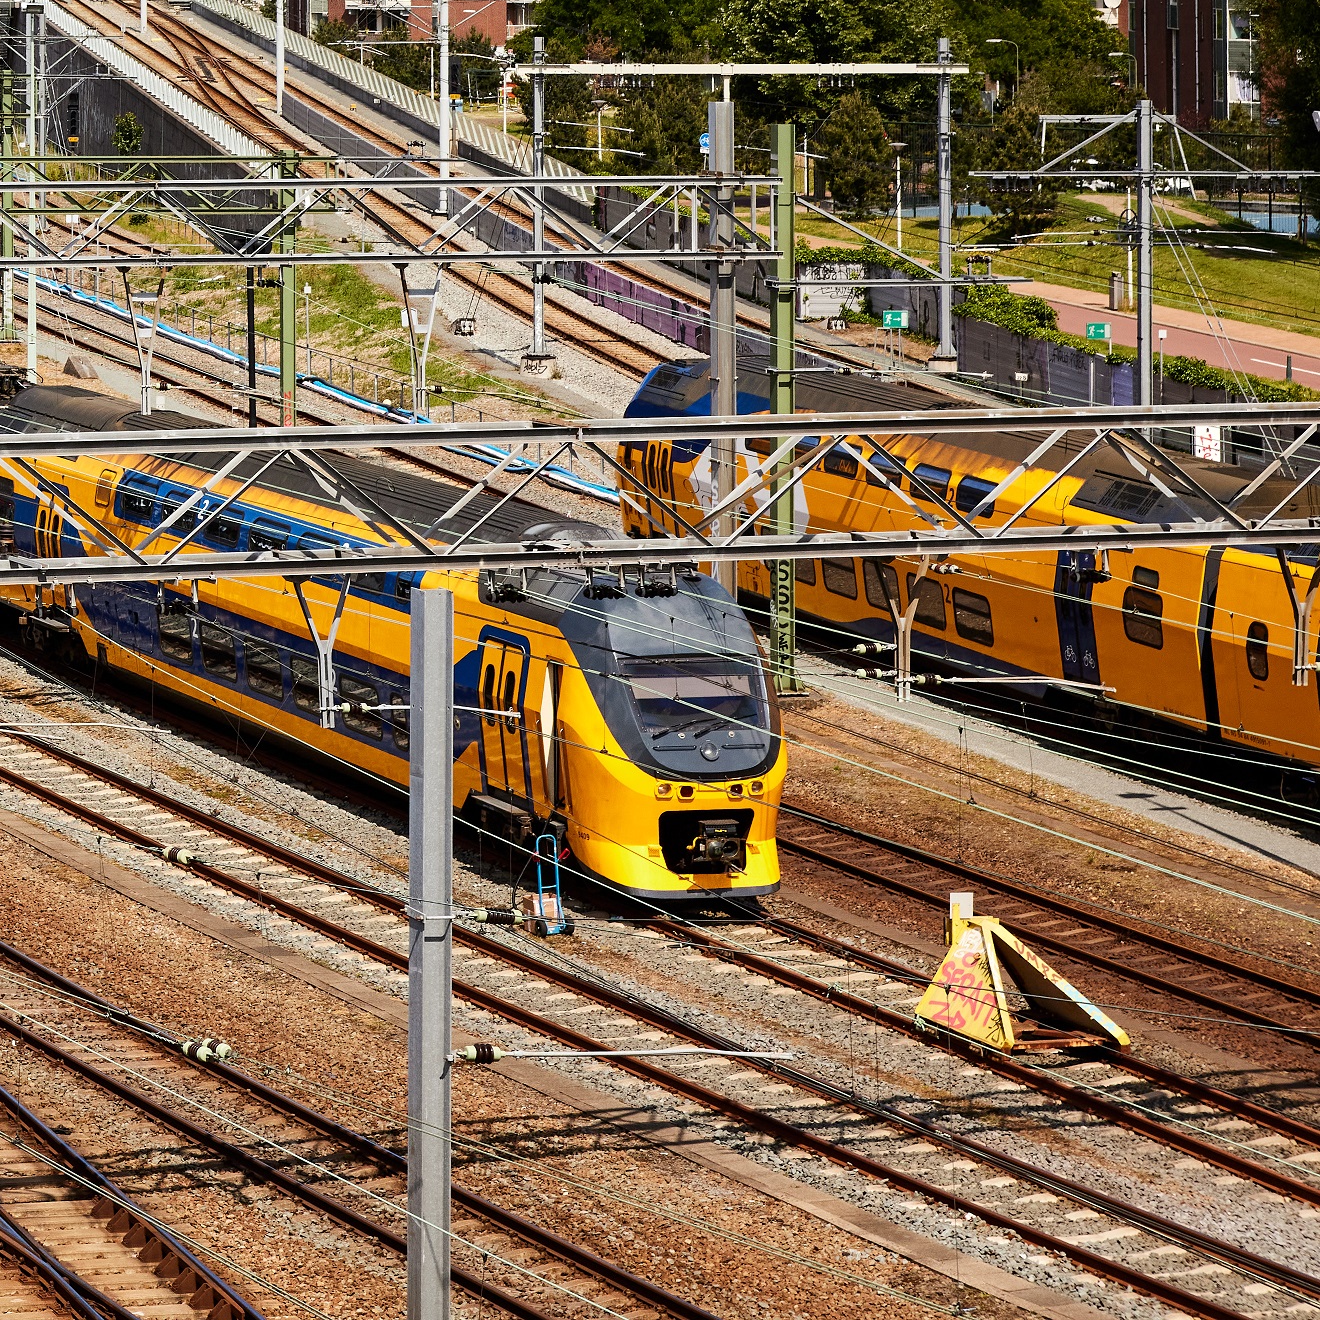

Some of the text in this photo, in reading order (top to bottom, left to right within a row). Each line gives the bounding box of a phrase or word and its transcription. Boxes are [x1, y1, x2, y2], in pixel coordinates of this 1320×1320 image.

[947, 487, 955, 508] 2
[197, 499, 210, 521] 2
[944, 583, 951, 604] 2
[190, 617, 199, 639] 2
